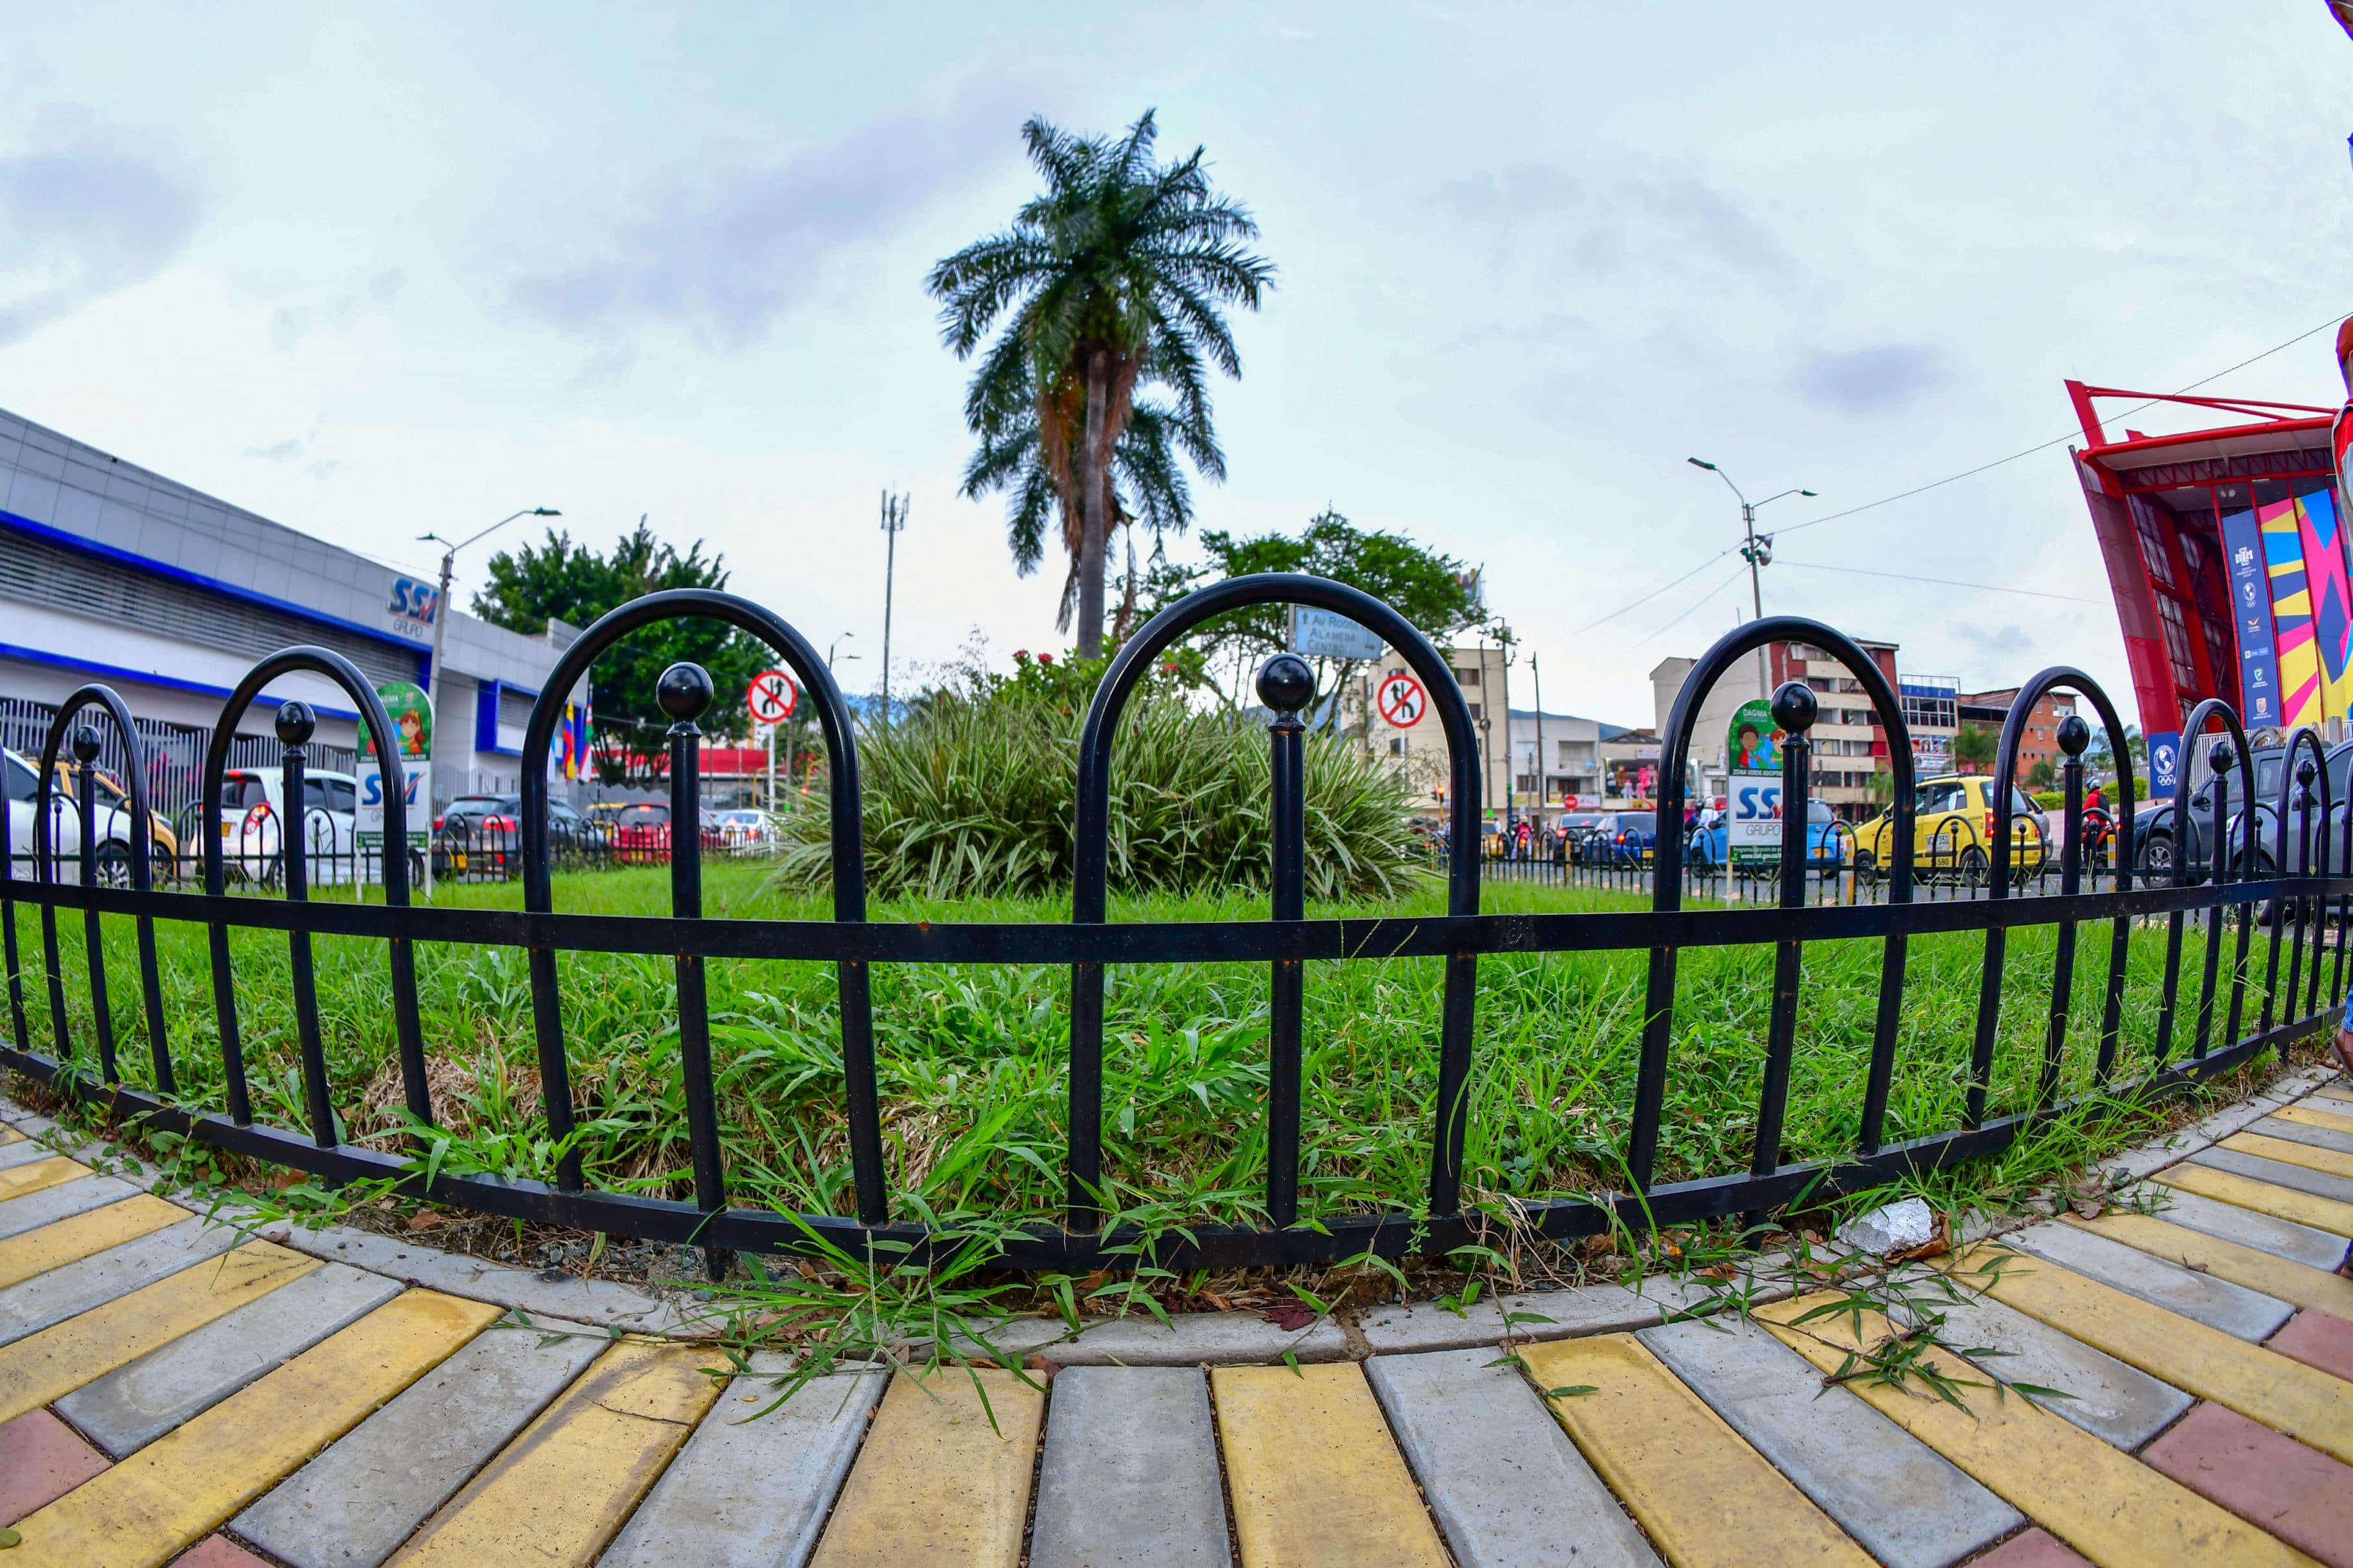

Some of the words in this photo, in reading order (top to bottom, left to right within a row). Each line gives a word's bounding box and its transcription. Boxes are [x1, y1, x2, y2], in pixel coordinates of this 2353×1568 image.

[393, 619, 423, 638] GRUPO
[1743, 709, 1767, 718] DAGMA
[1746, 824, 1781, 836] GRUPO
